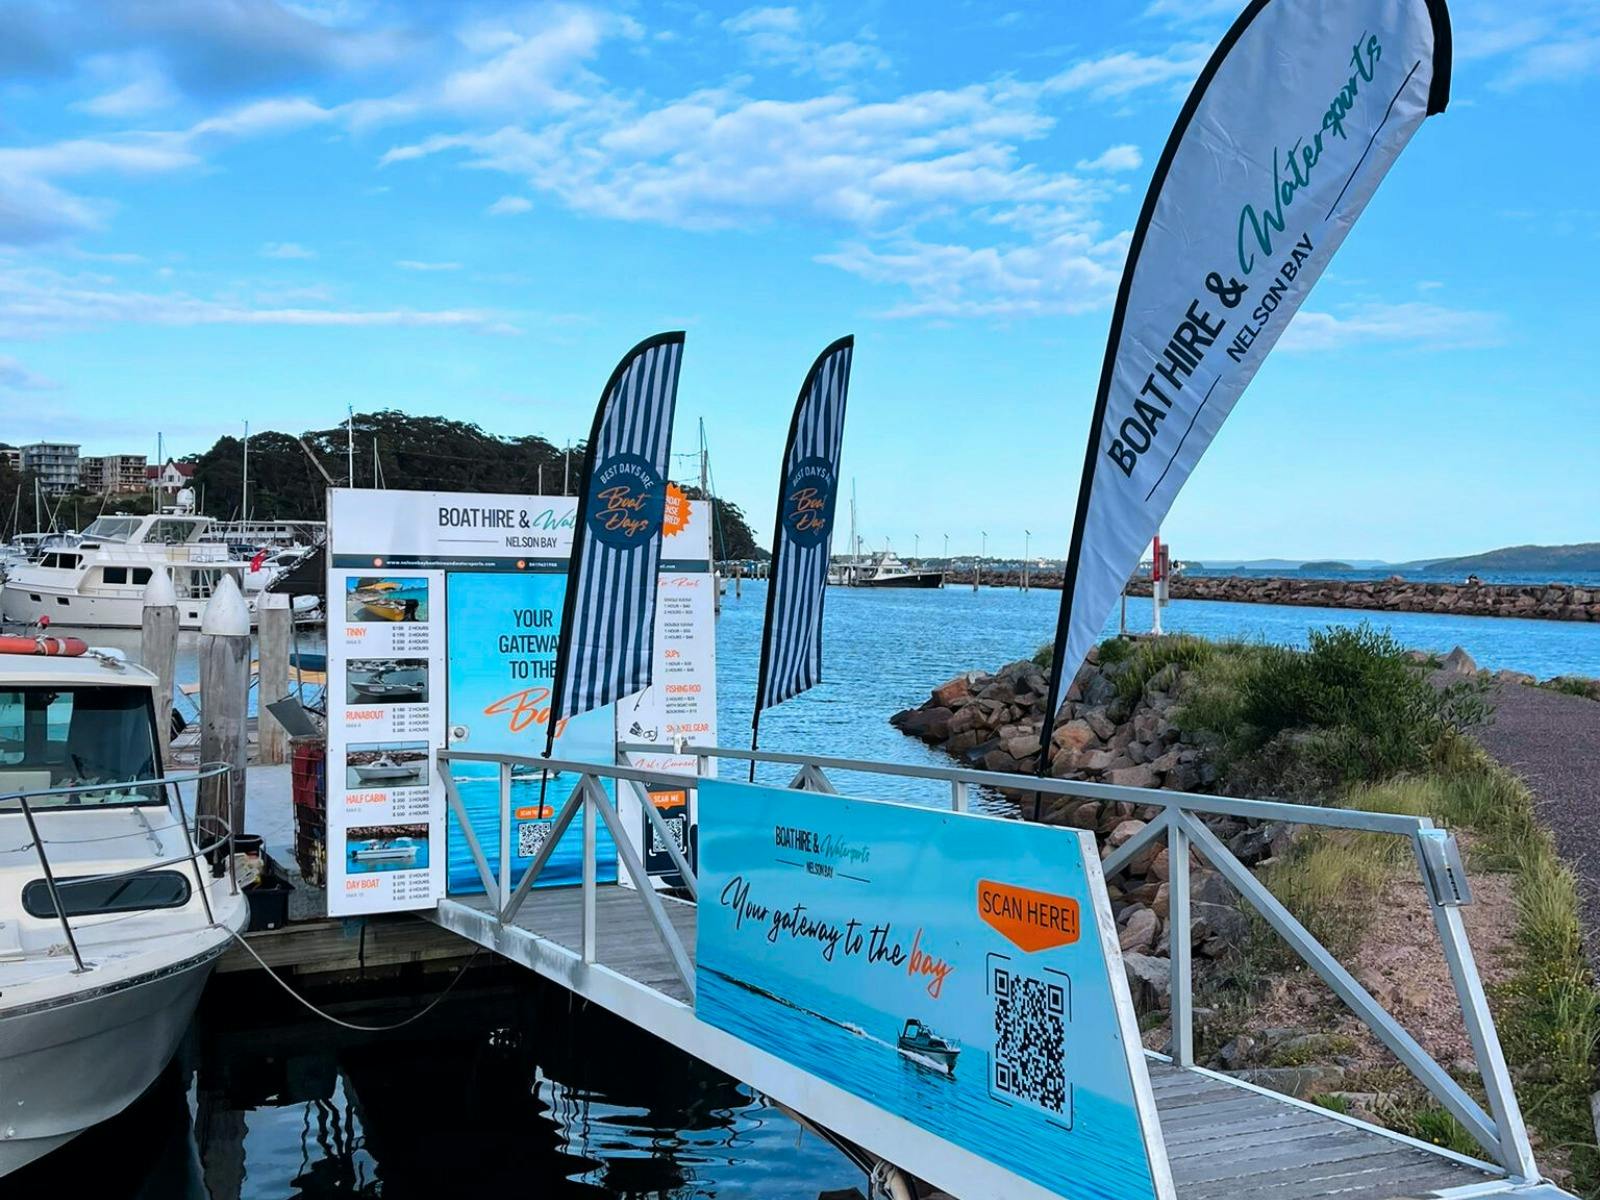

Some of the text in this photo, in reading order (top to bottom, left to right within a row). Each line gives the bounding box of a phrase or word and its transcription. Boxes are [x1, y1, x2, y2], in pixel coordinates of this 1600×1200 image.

[1206, 271, 1249, 309] &
[1238, 30, 1382, 275] Watersports
[1226, 232, 1314, 363] NELSON BAY
[600, 463, 654, 490] BEST DAYS ARE
[804, 466, 827, 479] DAYS
[598, 486, 651, 511] Boat
[519, 510, 530, 529] &
[596, 508, 648, 537] Days
[505, 536, 558, 548] NELSON BAY
[513, 609, 553, 628] YOUR
[346, 627, 367, 637] TINNY
[499, 634, 560, 653] GATEWA
[509, 660, 556, 679] TO THE
[665, 684, 701, 693] FISHING ROD
[346, 711, 384, 720] RUNABOUT
[692, 723, 709, 732] GEAR
[346, 794, 364, 804] HALF
[365, 792, 387, 803] CABIN
[812, 832, 820, 854] &
[819, 833, 870, 864] Watersports
[806, 861, 833, 878] NELSON BAY
[346, 879, 380, 890] DAY BOAT
[982, 891, 1075, 934] SCAN HERE!
[721, 876, 954, 999] Your gateway to the bay
